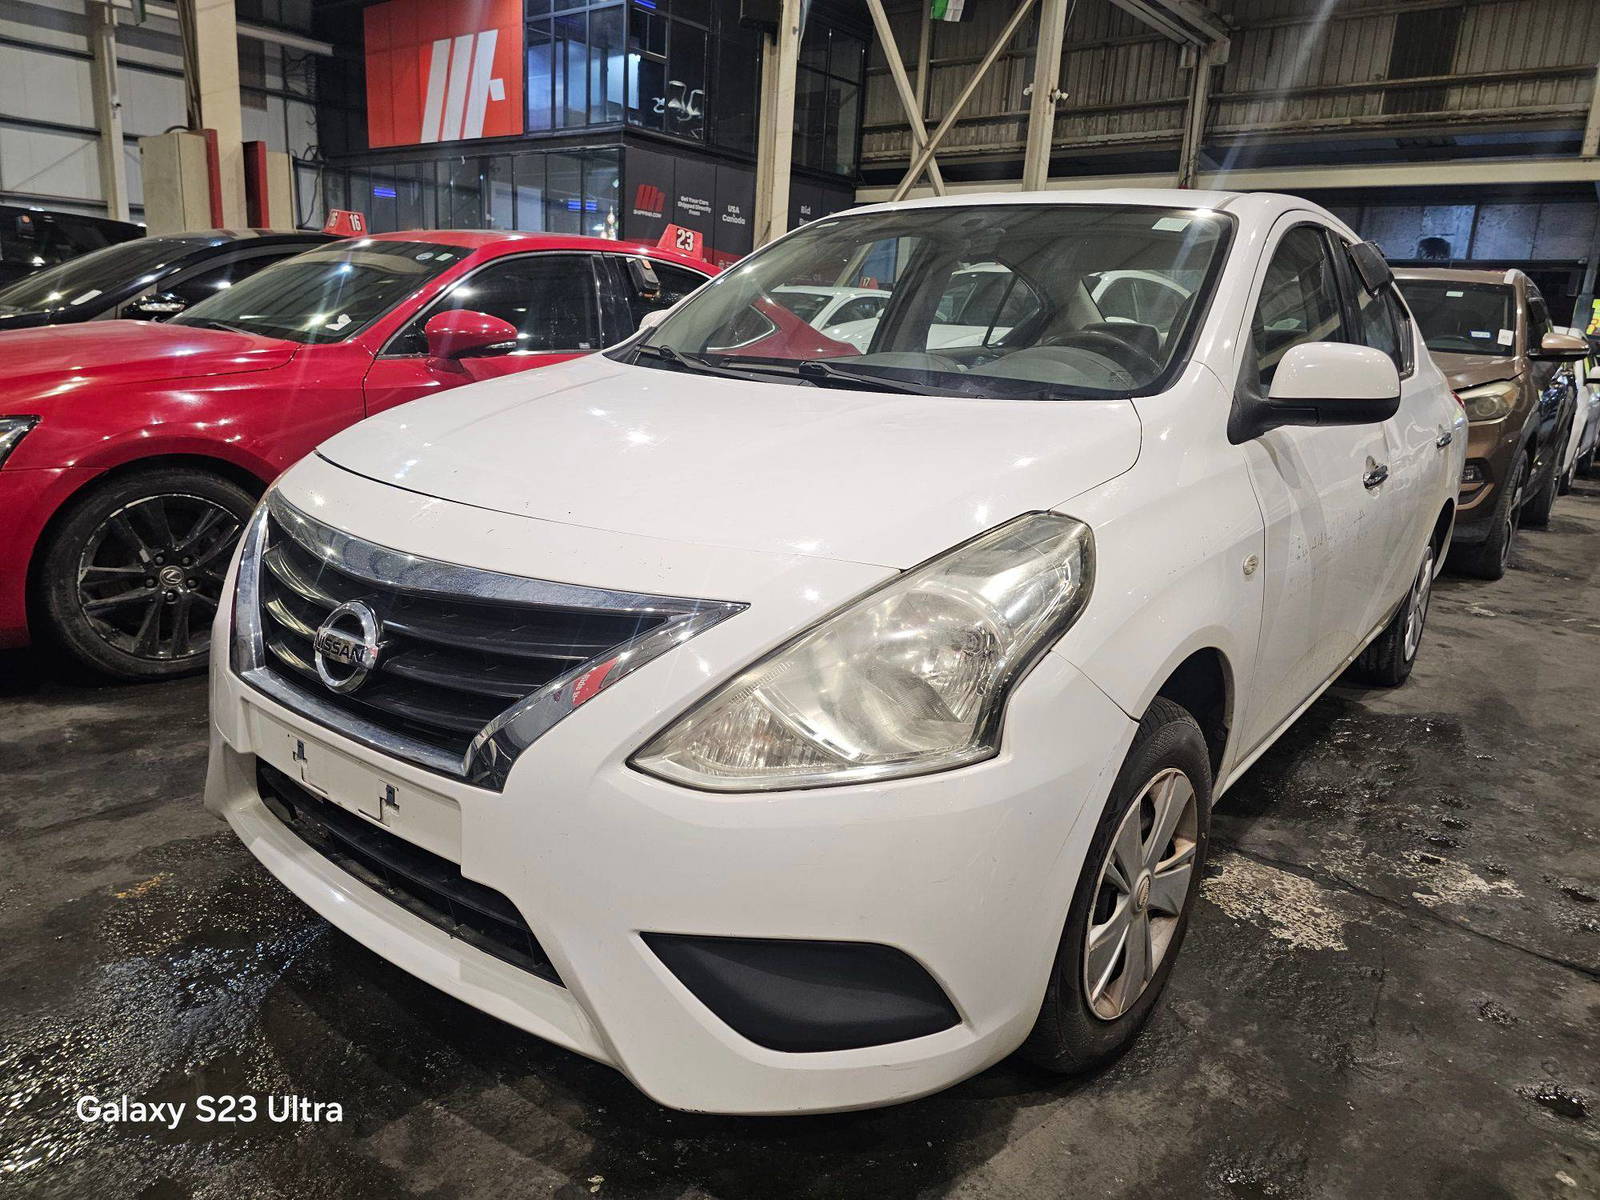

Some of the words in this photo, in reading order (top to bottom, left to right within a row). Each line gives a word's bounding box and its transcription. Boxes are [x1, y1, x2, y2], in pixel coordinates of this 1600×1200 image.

[727, 204, 740, 214] USA
[349, 213, 362, 231] 16
[722, 214, 746, 225] Canada
[676, 228, 694, 252] 23
[314, 630, 366, 663] NISSAN
